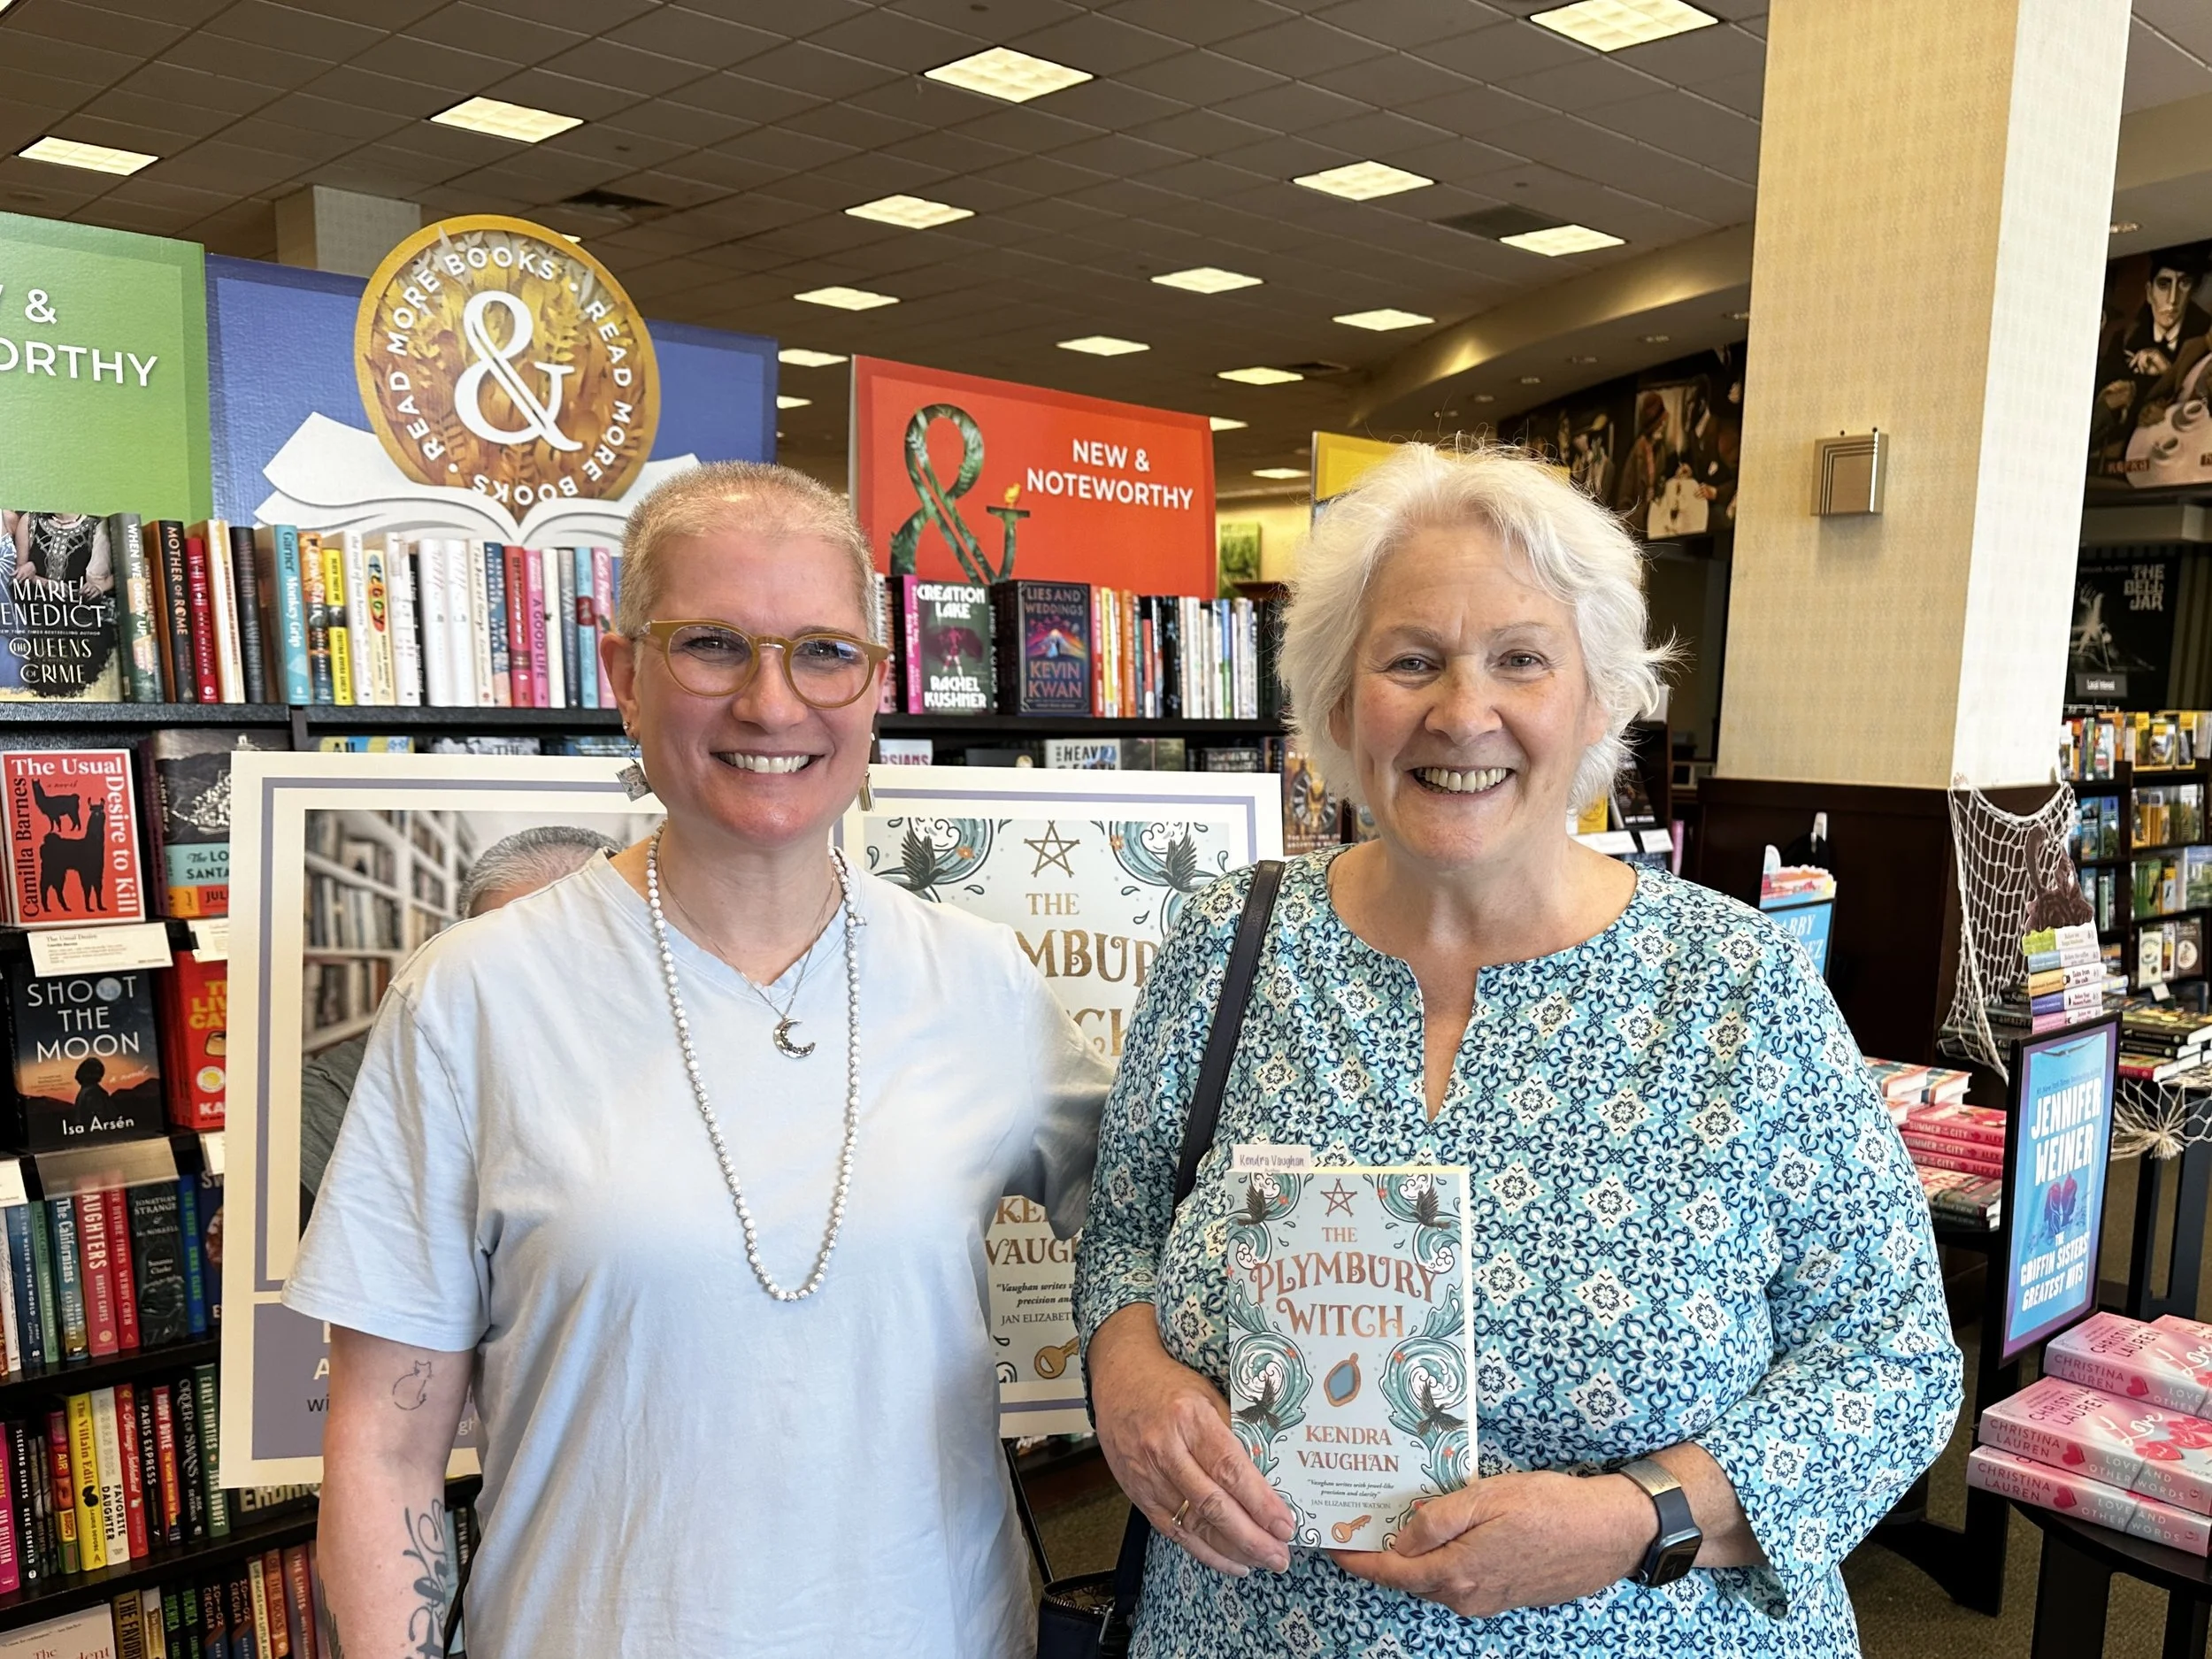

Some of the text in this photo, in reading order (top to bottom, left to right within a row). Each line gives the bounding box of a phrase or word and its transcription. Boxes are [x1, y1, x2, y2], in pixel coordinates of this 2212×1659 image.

[24, 288, 57, 324] &
[387, 246, 556, 462] READ MORE BOOKS
[584, 301, 634, 387] READ
[0, 338, 158, 387] ORTHY
[455, 290, 582, 451] &
[582, 400, 632, 481] MORE
[1072, 439, 1149, 472] NEW &
[472, 474, 578, 505] BOOKS
[1026, 468, 1194, 509] NOTEWORTHY
[166, 526, 182, 581] MOTHER
[282, 532, 296, 572] Garner
[127, 523, 147, 635] WHEN WE GROW UP
[2131, 564, 2165, 580] THE
[13, 579, 82, 603] MARIE
[367, 562, 387, 625] PEGGY
[532, 597, 541, 606] A
[917, 585, 986, 603] CREATION
[1027, 588, 1081, 602] LIES AND
[2124, 579, 2165, 596] BELL
[0, 603, 105, 627] ENEDICT
[173, 599, 188, 635] ROME
[286, 577, 301, 648] Monkey Grip
[356, 599, 366, 626] hearts
[561, 586, 575, 623] WAY
[935, 603, 971, 618] LAKE
[1025, 603, 1083, 616] WEDDINGS
[2130, 595, 2163, 612] JAR
[532, 610, 544, 649] GOOD
[9, 638, 91, 660] QUEENS
[20, 664, 86, 683] CRIME
[534, 652, 546, 679] LIFE
[1030, 661, 1079, 679] KEVIN
[930, 676, 979, 692] RACHEL
[1028, 681, 1082, 698] KWAN
[925, 692, 987, 708] KUSHNER
[12, 757, 123, 775] The Usual
[13, 778, 40, 917] Camilla Barnes
[105, 776, 138, 912] Desire to Kill
[1025, 892, 1080, 915] THE
[27, 976, 137, 1006] SHOOT
[58, 1006, 110, 1033] THE
[36, 1032, 140, 1063] MOON
[2031, 1076, 2103, 1140] JENNIFER
[62, 1116, 134, 1135] Isa Arsén
[1909, 1121, 1968, 1139] SUMMER CITY
[1240, 1153, 1304, 1168] Kendra Vaughan
[1906, 1137, 1963, 1156] SUMMER CITY
[2034, 1122, 2094, 1187] WEINER
[1937, 1157, 1955, 1169] CITY
[134, 1203, 176, 1215] STRANGE
[135, 1195, 176, 1206] JONATHAN
[55, 1198, 75, 1283] The Californians
[1322, 1226, 1358, 1242] THE
[2055, 1231, 2065, 1248] THE
[986, 1237, 1078, 1265] VAUG
[25, 1263, 31, 1272] IN
[1249, 1251, 1440, 1303] PLYMBURY
[2021, 1250, 2055, 1286] GRIFFIN
[1041, 1282, 1066, 1292] writes
[2022, 1261, 2084, 1310] GREATEST HITS
[27, 1290, 35, 1316] WORLD
[1017, 1295, 1056, 1307] precision
[1001, 1313, 1073, 1325] JAN ELIZABET
[1276, 1297, 1404, 1338] WITCH
[2090, 1324, 2142, 1354] CHRISTINA
[2116, 1330, 2162, 1357] LAUREN
[2054, 1354, 2124, 1382] CHRISTINA
[2061, 1368, 2114, 1390] LAUREN
[2029, 1389, 2093, 1421] CHRISTINA
[2154, 1395, 2194, 1412] OTHER
[2169, 1387, 2201, 1403] LOVE
[156, 1394, 173, 1449] RODDY DOYLE
[199, 1376, 218, 1449] EARLY THIRTIES
[2053, 1396, 2111, 1426] LAUREN
[177, 1379, 199, 1478] ORDER SWANS
[1306, 1425, 1392, 1446] KENDRA
[1991, 1419, 2060, 1449] CHRISTINA
[2093, 1411, 2164, 1446] Love
[76, 1400, 94, 1486] The Villain Edit
[138, 1404, 157, 1485] PARIS EXPRESS
[1996, 1433, 2050, 1458] LAUREN
[14, 1428, 29, 1499] SLEEPING GIANTS
[1297, 1450, 1400, 1472] VAUGHAN
[2106, 1455, 2171, 1483] LOVE AND
[1978, 1462, 2051, 1493] CHRISTINA
[1984, 1477, 2039, 1502] LAUREN
[2088, 1463, 2185, 1501] OTHER WORDS
[101, 1486, 114, 1540] DAUGHTER
[112, 1484, 126, 1536] FAVORITE
[209, 1493, 225, 1526] DUBOFF
[1325, 1500, 1362, 1509] ELIZABETH
[1363, 1501, 1391, 1509] WATSON
[2097, 1497, 2166, 1525] LOVE AND
[2081, 1507, 2180, 1542] OTHER WORDS
[25, 1530, 35, 1563] DENFELD
[292, 1554, 306, 1609] THE LIMITS
[119, 1596, 138, 1620] THE
[203, 1586, 214, 1629] CIRCULAR
[229, 1581, 242, 1624] CIRCULAR
[273, 1599, 284, 1628] BOOKS
[33, 1647, 58, 1659] The
